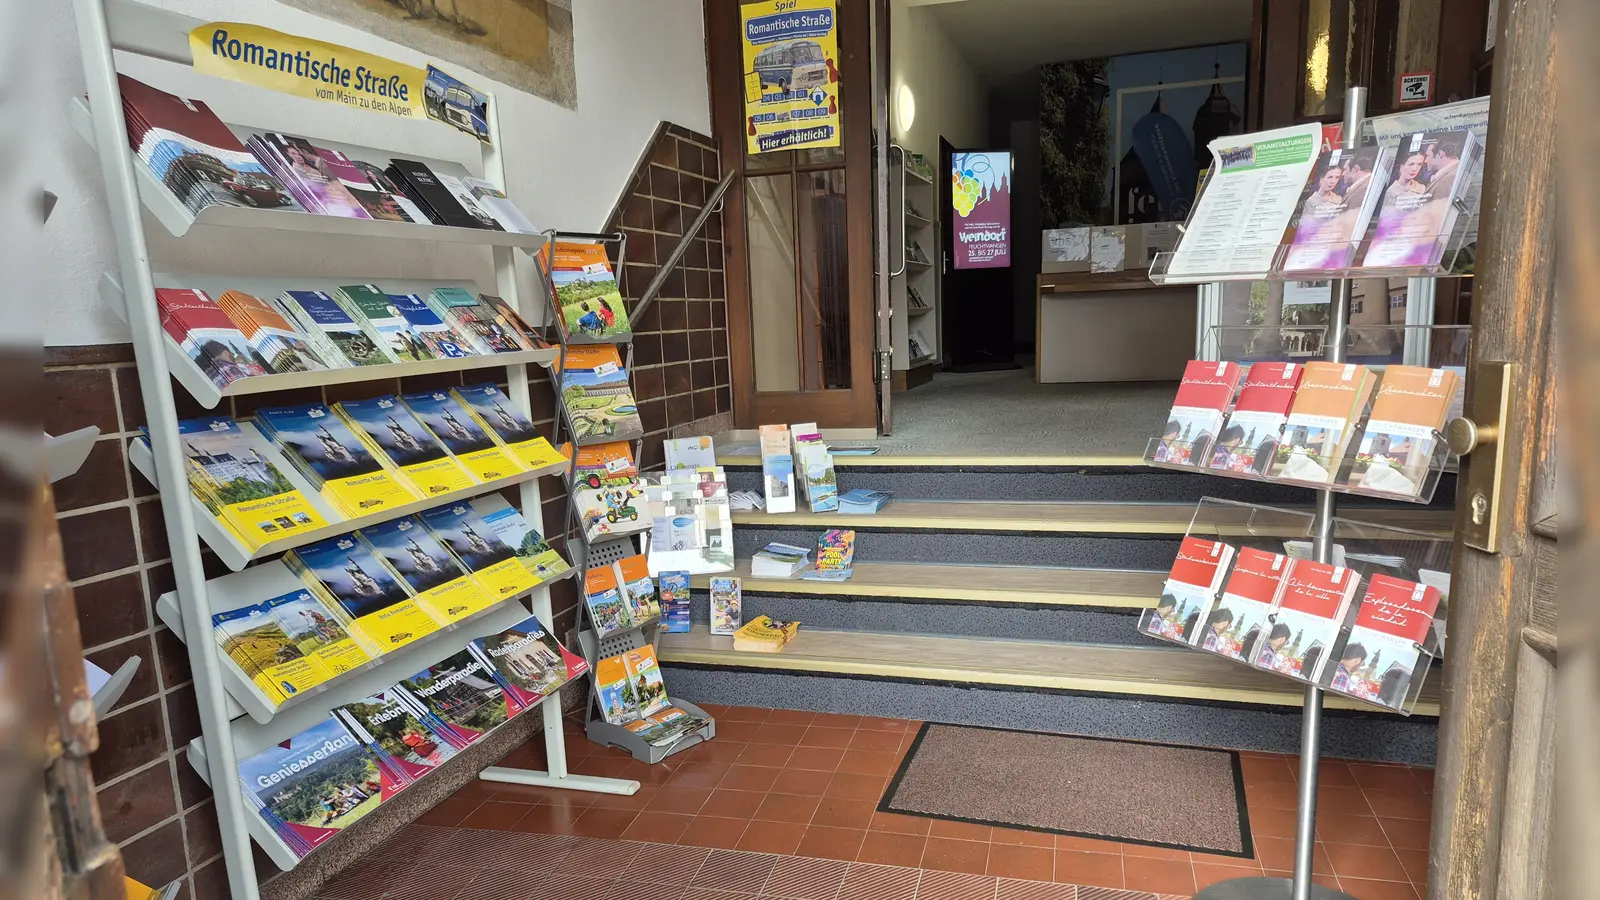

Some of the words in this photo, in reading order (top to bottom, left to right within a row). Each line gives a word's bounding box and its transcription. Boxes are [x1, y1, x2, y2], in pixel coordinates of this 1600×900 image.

[775, 0, 797, 12] Spiel
[748, 18, 800, 35] Romantische
[801, 14, 831, 27] Straße
[212, 29, 351, 88] Romantische
[354, 65, 409, 101] Straße
[1403, 76, 1428, 84] ACHTUNG!
[315, 87, 334, 100] vom
[336, 90, 357, 106] Main
[359, 97, 369, 108] zu
[371, 98, 387, 112] den
[389, 101, 412, 117] Alpen
[762, 137, 779, 150] Hier
[781, 128, 827, 146] erhältlich!
[1379, 132, 1390, 142] Mit
[1391, 131, 1401, 140] uns
[1428, 124, 1449, 133] keine
[1255, 137, 1312, 151] VERANSTALTUNGEN
[959, 227, 1006, 244] Weindorf
[821, 558, 842, 566] PARTY
[825, 551, 841, 559] POOL
[487, 628, 547, 659] Radelparadies
[256, 732, 354, 790] Geniesserlan
